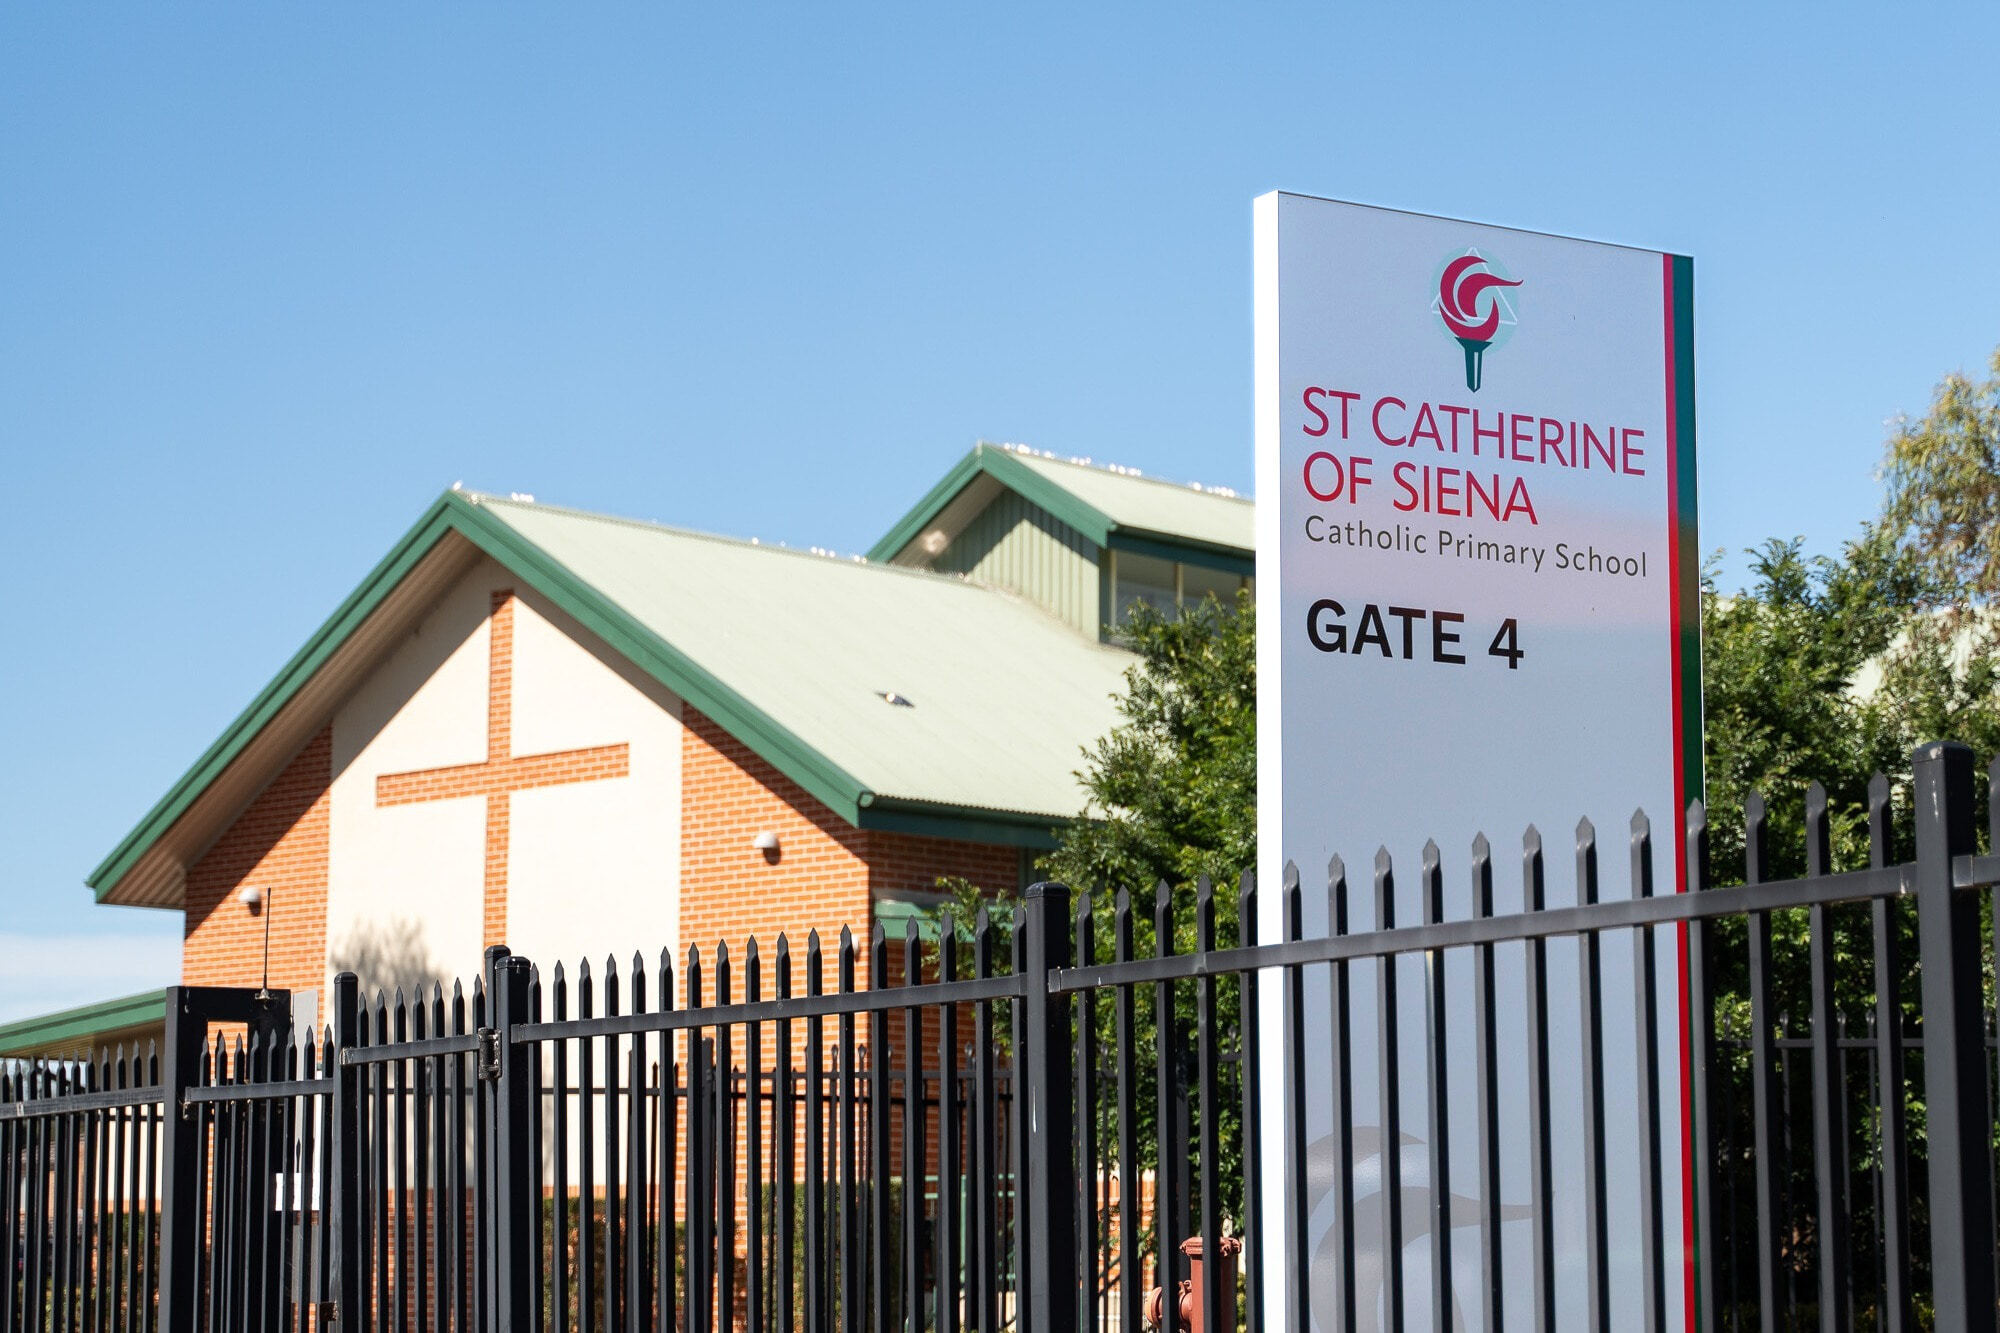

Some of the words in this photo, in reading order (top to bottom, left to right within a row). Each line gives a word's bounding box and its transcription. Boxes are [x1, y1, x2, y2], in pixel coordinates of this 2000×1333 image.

[1303, 387, 1361, 439] ST
[1372, 397, 1646, 477] CATHERINE
[1303, 451, 1373, 505] OF
[1393, 462, 1538, 526] SIENA
[1304, 515, 1427, 554] Catholic
[1438, 529, 1546, 574] Primary
[1555, 543, 1647, 578] School
[1306, 598, 1467, 666] GATE
[1488, 617, 1525, 671] 4
